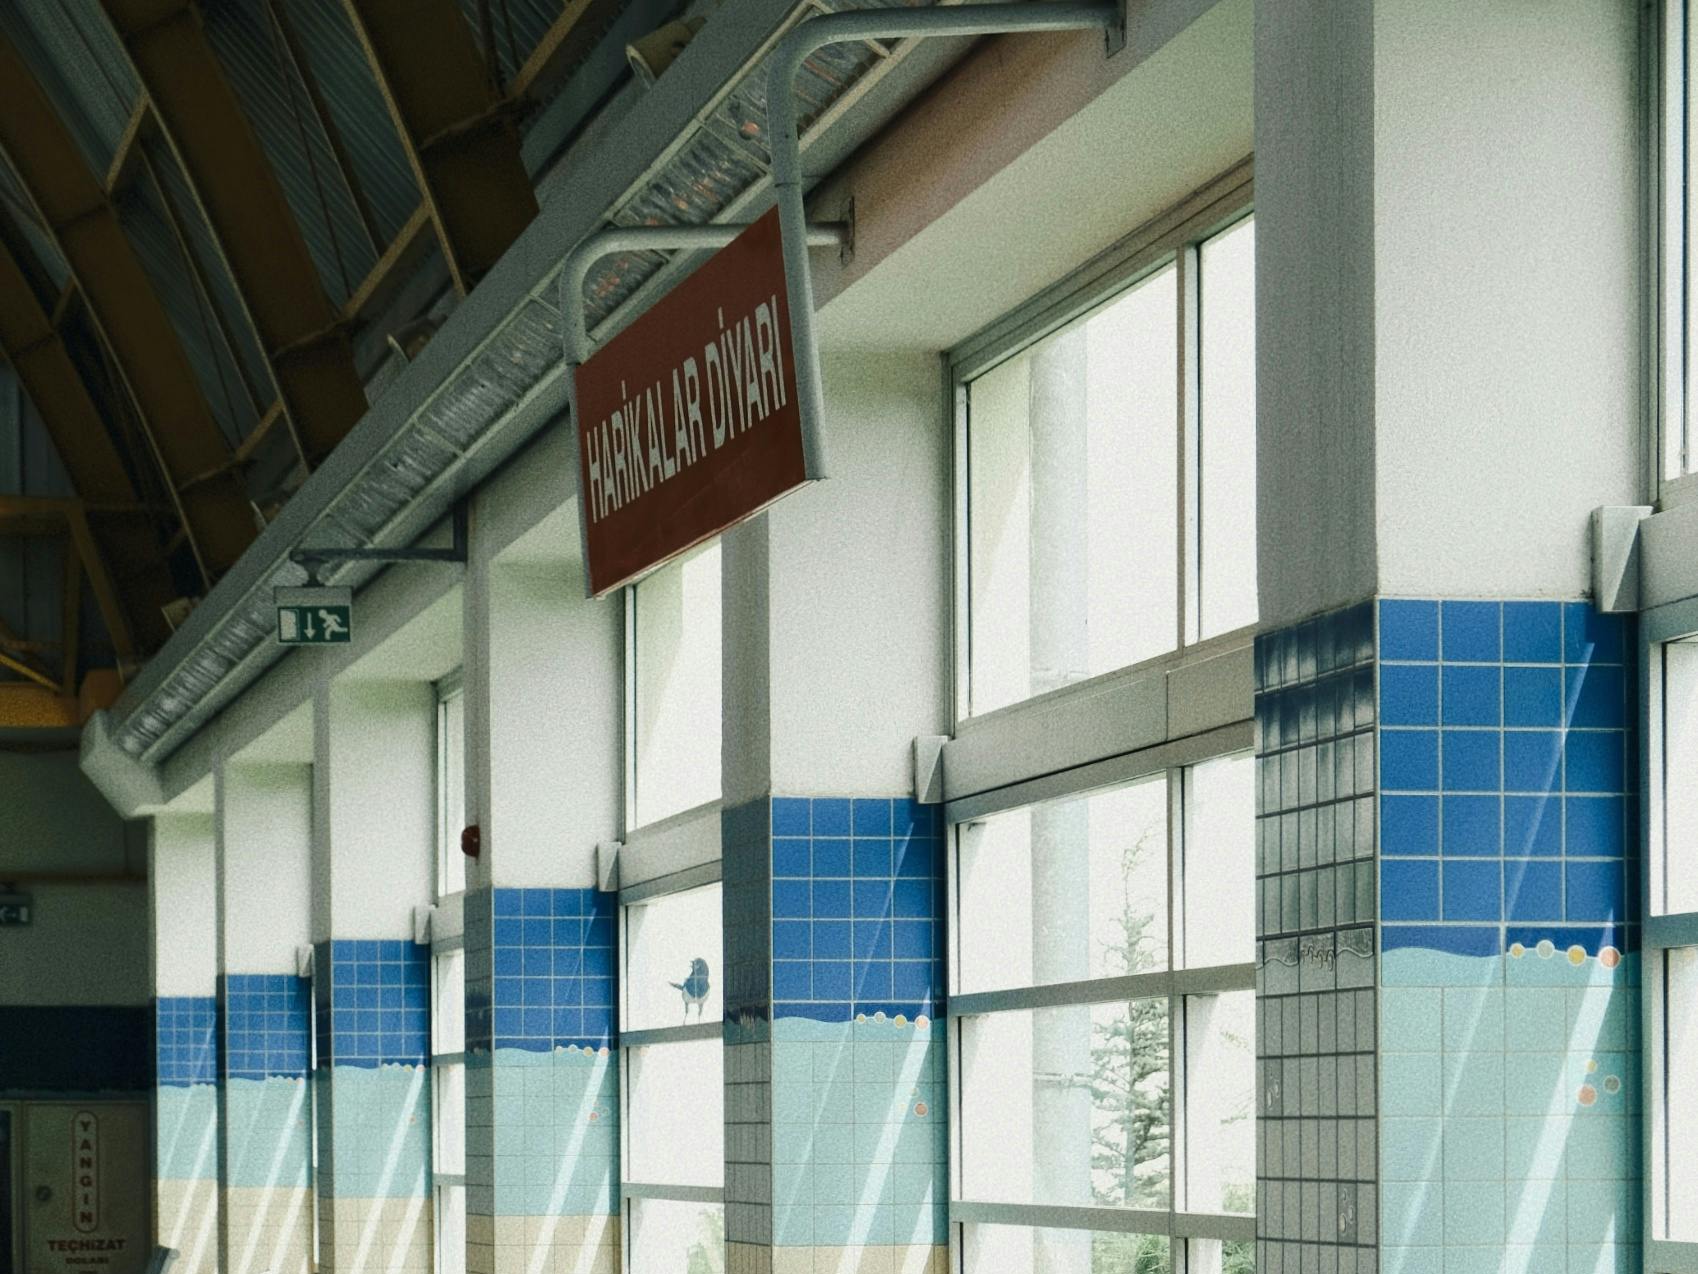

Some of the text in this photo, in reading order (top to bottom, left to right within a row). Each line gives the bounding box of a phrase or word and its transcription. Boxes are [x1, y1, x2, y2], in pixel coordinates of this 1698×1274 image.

[586, 294, 787, 523] HARİKALAR DİYARI
[79, 1120, 93, 1223] YANGIN
